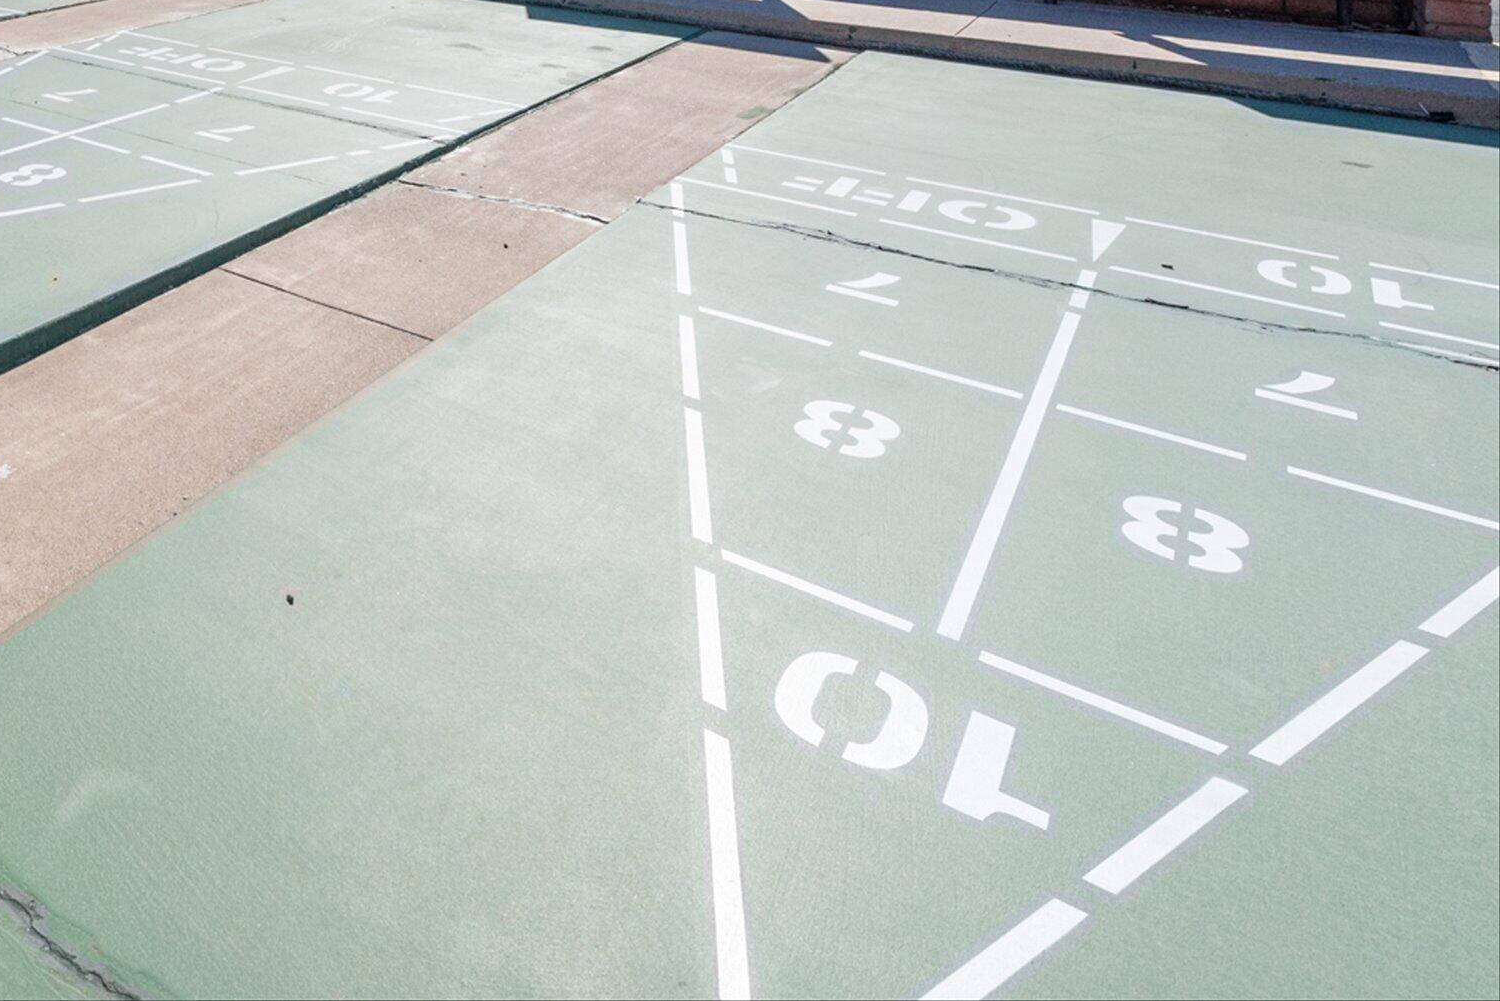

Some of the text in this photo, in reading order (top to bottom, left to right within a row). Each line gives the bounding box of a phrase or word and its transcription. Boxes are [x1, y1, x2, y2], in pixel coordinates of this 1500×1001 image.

[118, 47, 400, 104] 10 OFF
[780, 175, 1435, 311] 10 OFF
[825, 271, 902, 307] 7
[1254, 370, 1359, 421] 7
[792, 399, 901, 460] 8
[1121, 494, 1251, 575] 8
[773, 650, 1051, 831] 10
